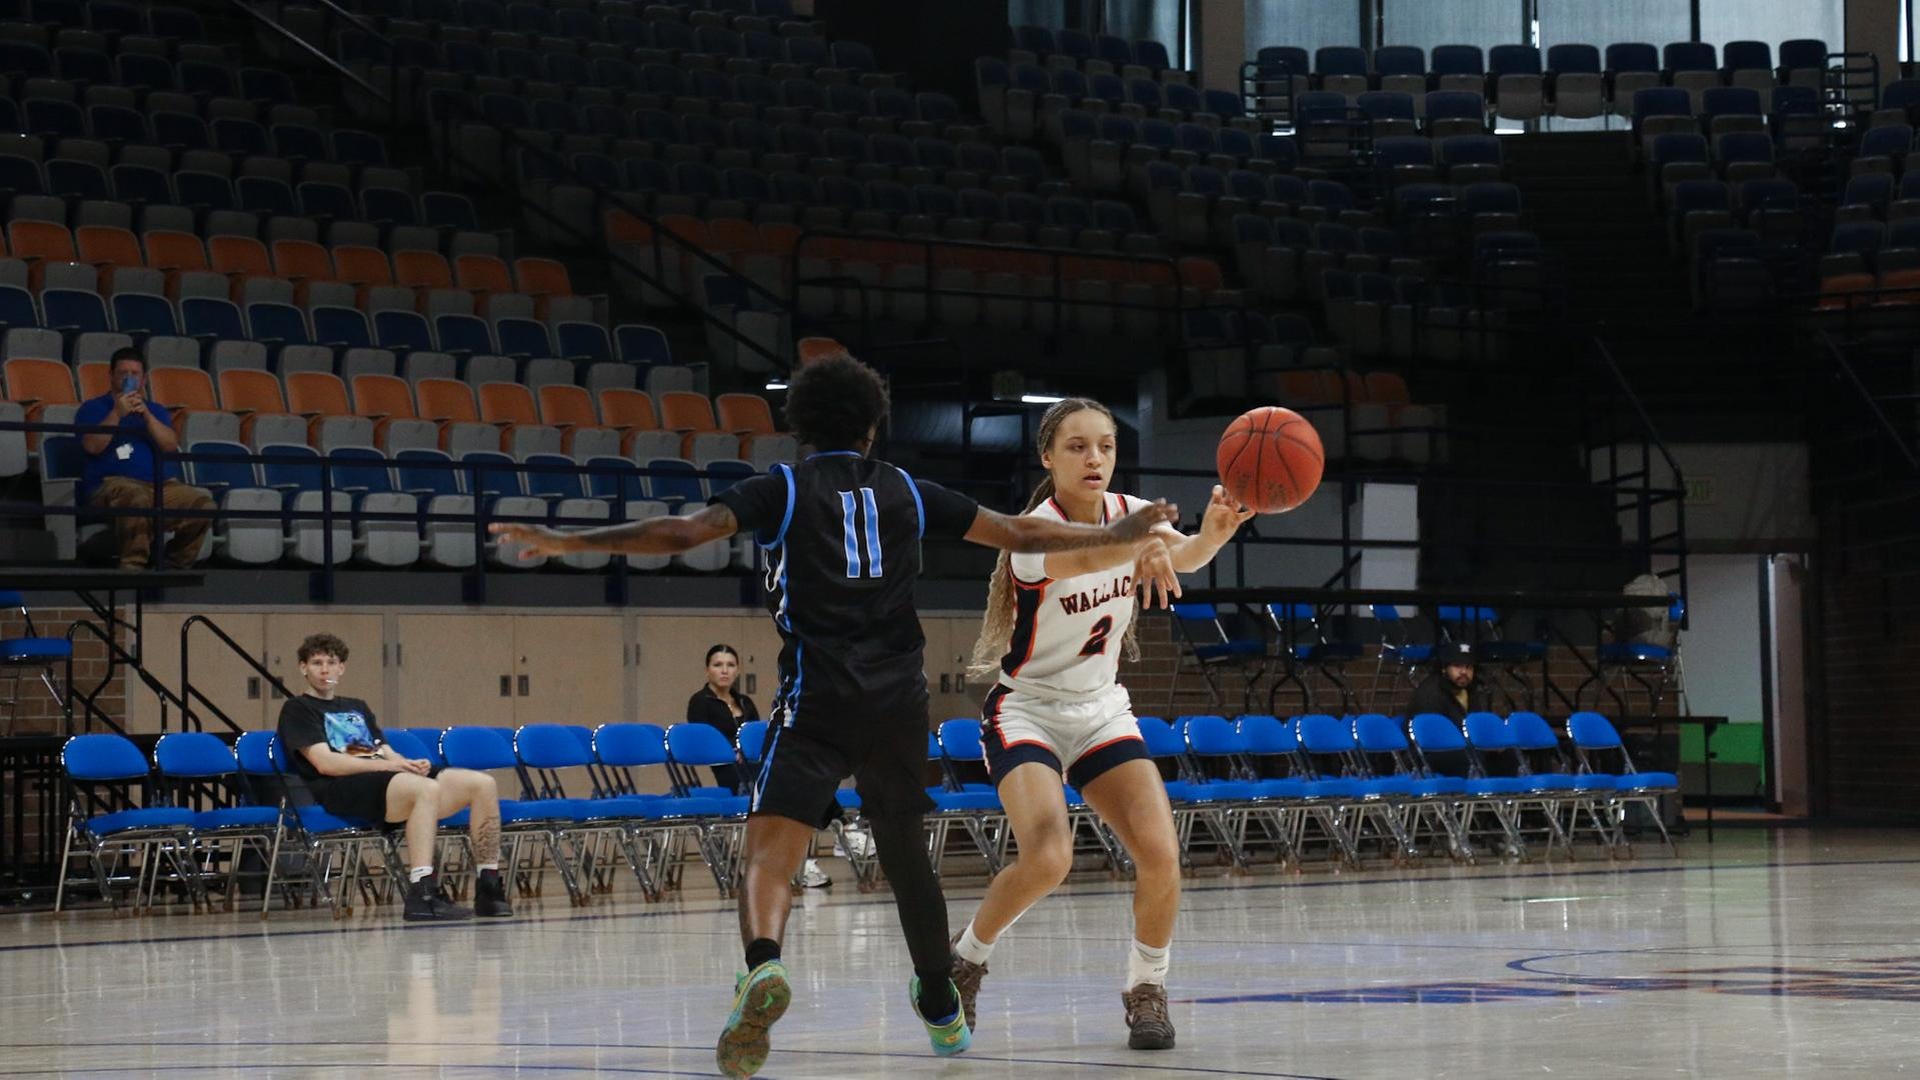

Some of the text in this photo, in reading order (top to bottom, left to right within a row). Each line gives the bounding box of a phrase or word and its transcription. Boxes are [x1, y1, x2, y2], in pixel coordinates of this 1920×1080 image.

[837, 487, 882, 578] 11
[1059, 576, 1132, 616] WALLAC
[1078, 614, 1114, 657] 2
